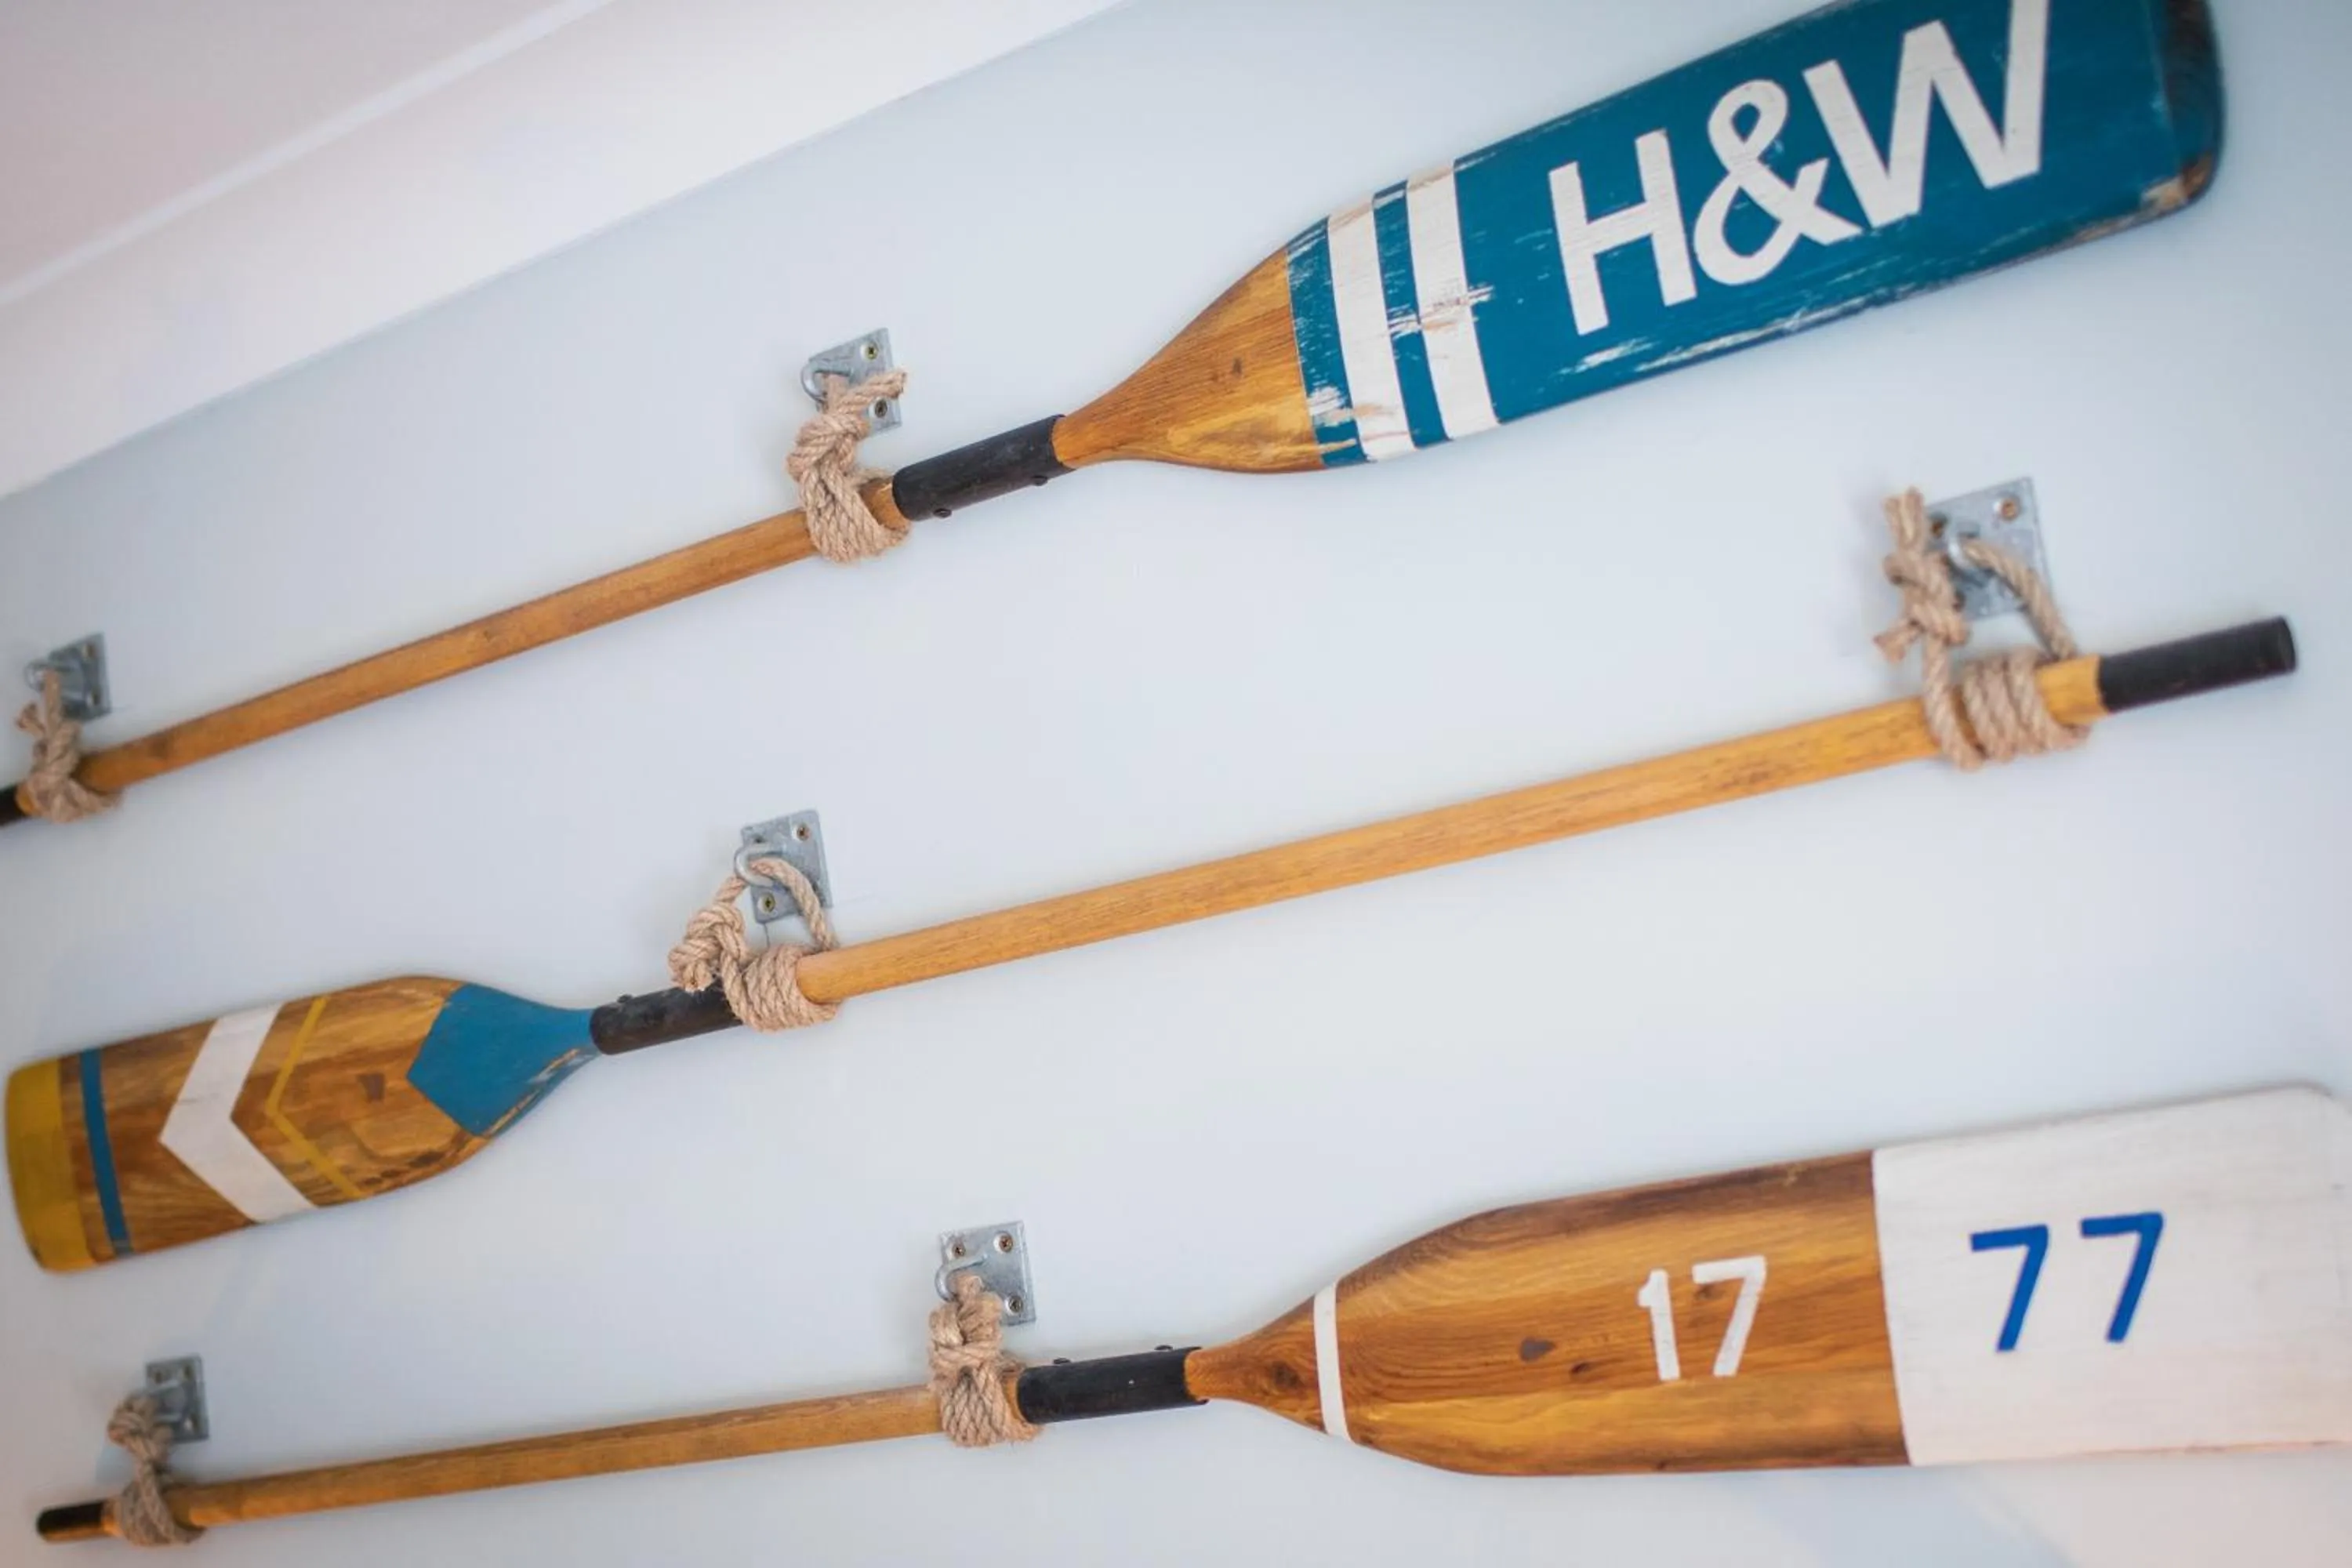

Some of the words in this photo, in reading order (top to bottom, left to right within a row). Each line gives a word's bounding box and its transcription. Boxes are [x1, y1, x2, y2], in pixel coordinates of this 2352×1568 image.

[1548, 0, 2048, 336] H&W
[1637, 1256, 1767, 1381] 17
[1969, 1211, 2165, 1352] 77
